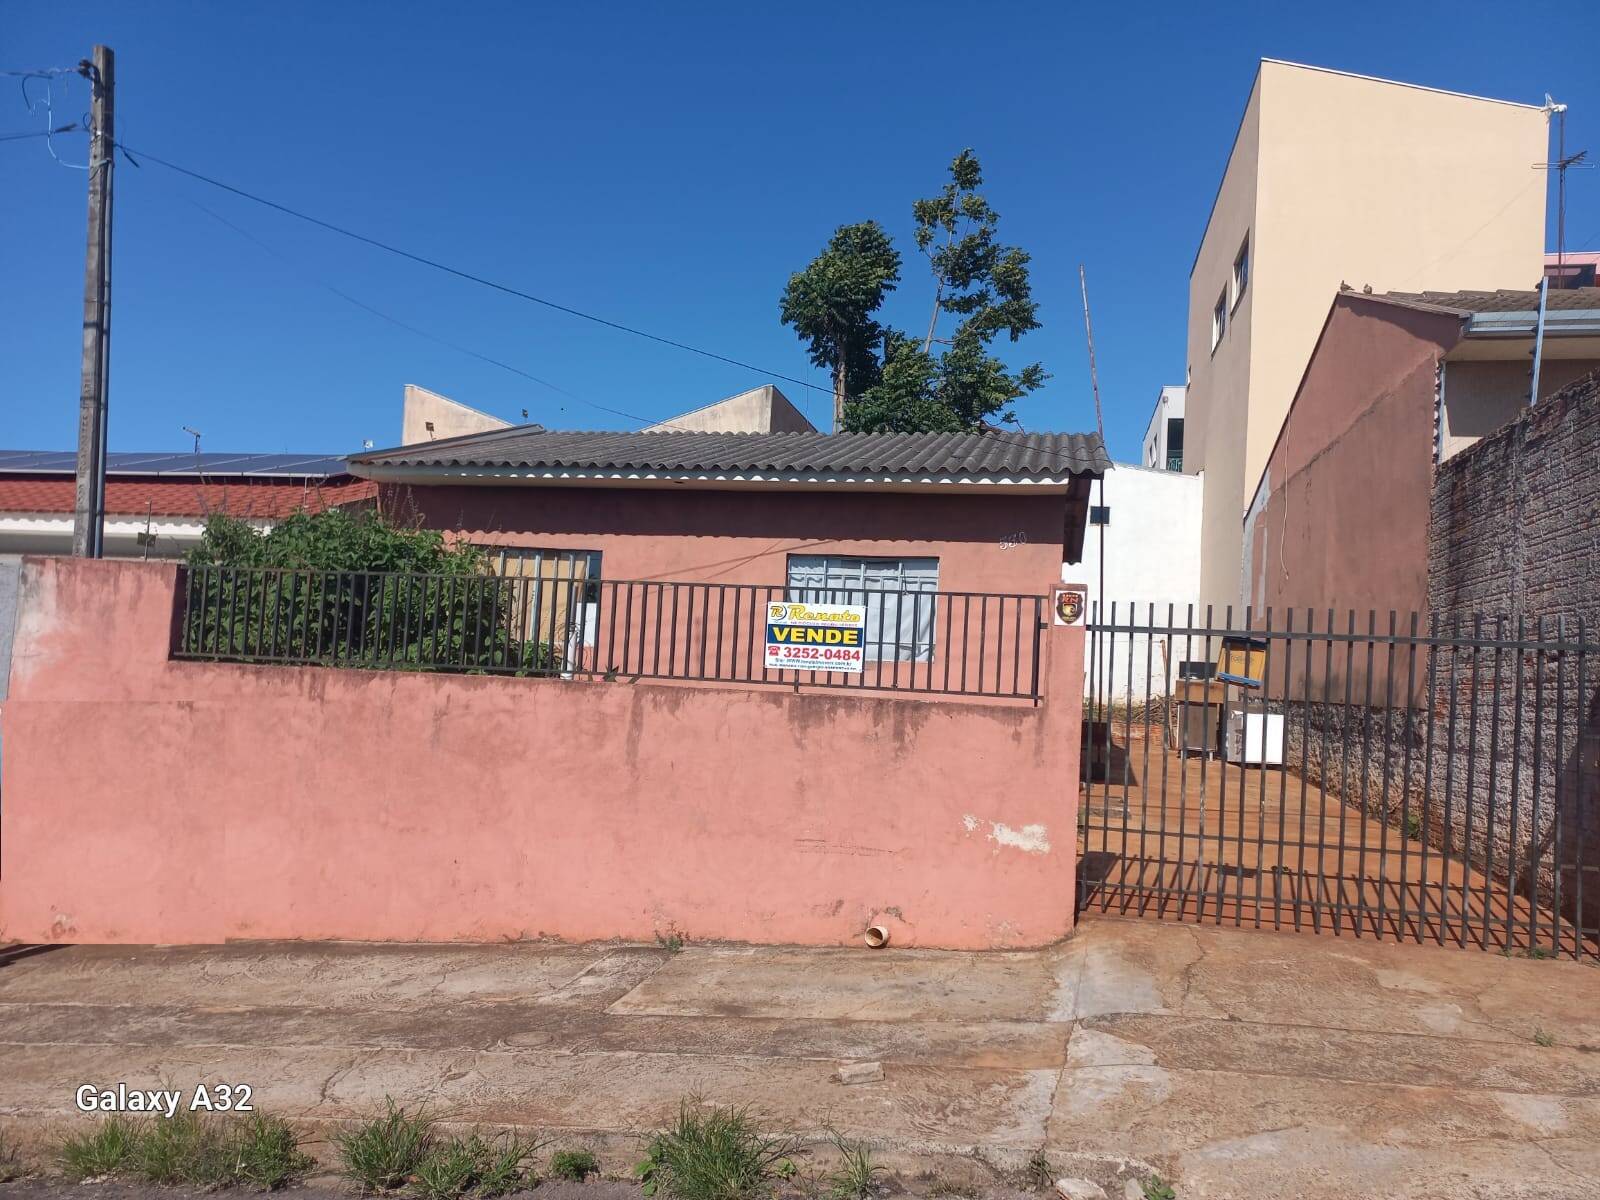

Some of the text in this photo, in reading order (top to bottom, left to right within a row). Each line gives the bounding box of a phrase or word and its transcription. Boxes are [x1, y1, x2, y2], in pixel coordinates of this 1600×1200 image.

[788, 604, 861, 623] Renato
[772, 627, 858, 645] VENDE
[783, 647, 861, 662] 3252-0484
